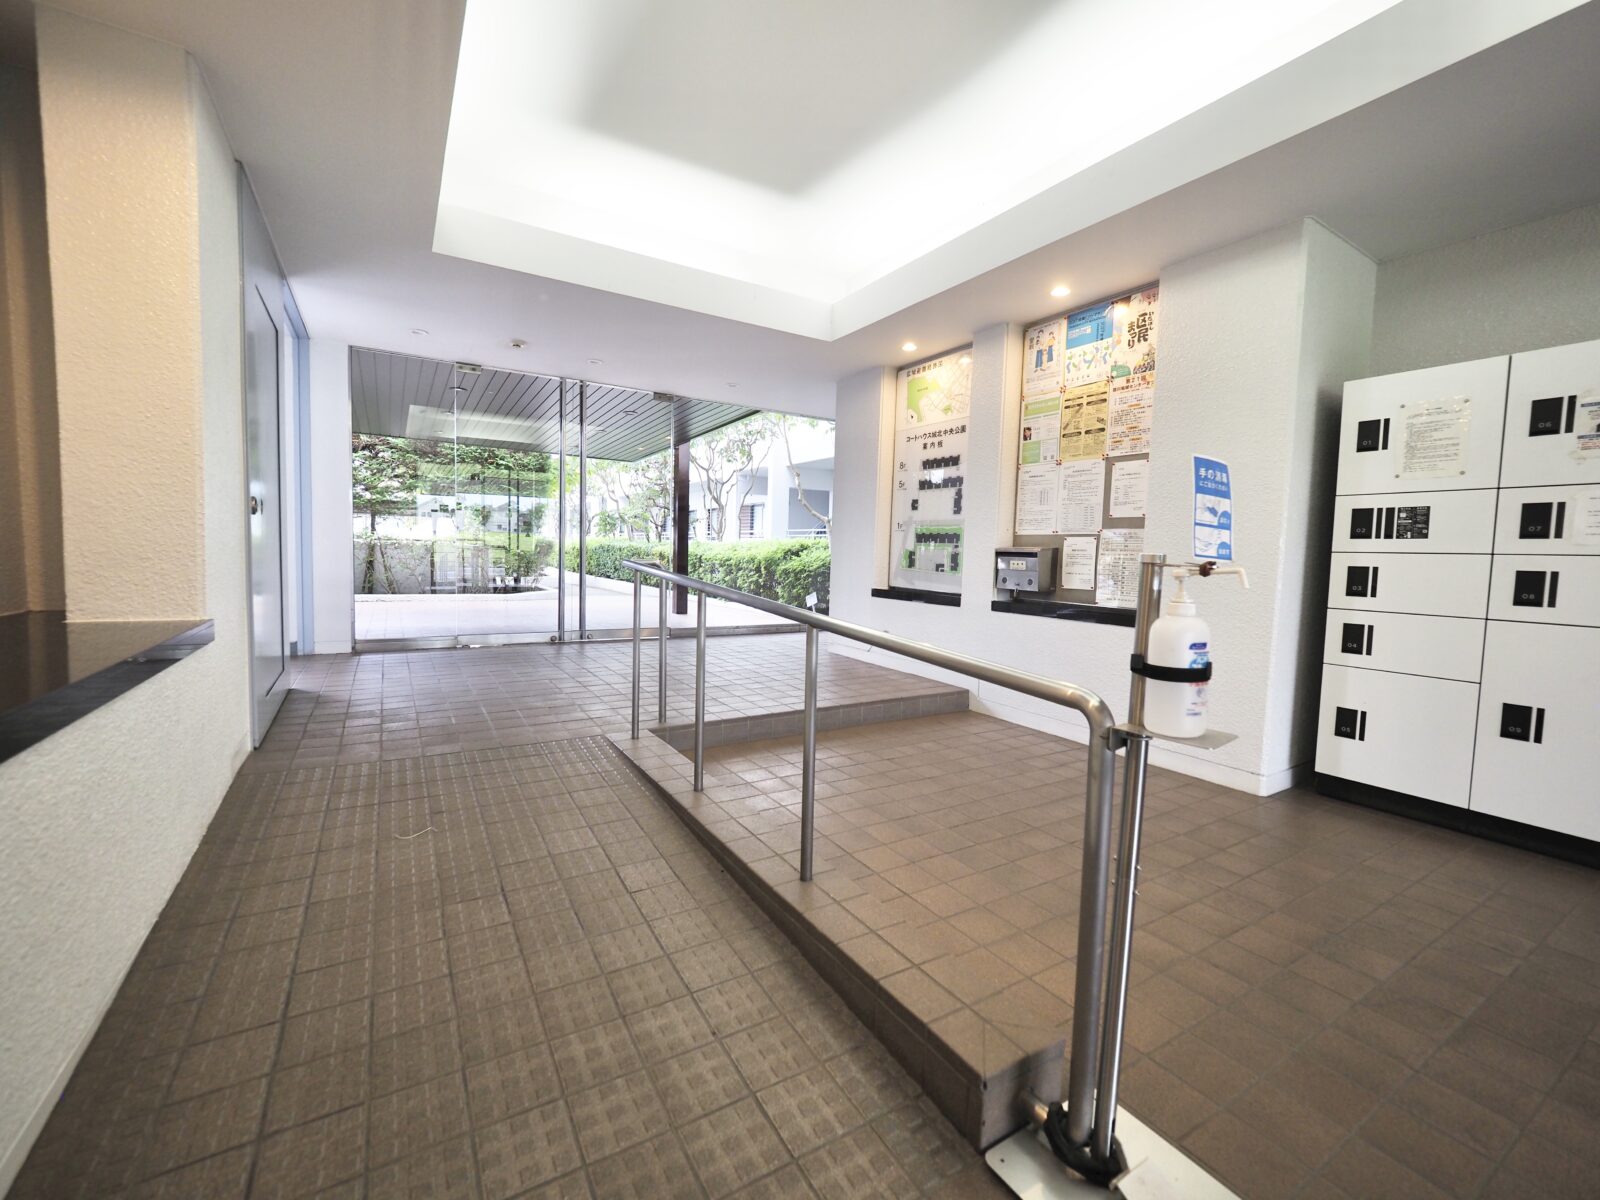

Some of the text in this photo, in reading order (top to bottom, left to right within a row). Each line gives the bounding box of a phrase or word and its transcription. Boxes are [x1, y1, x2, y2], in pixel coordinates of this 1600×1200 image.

[1127, 321, 1138, 349] まつり
[1136, 312, 1149, 343] 区民
